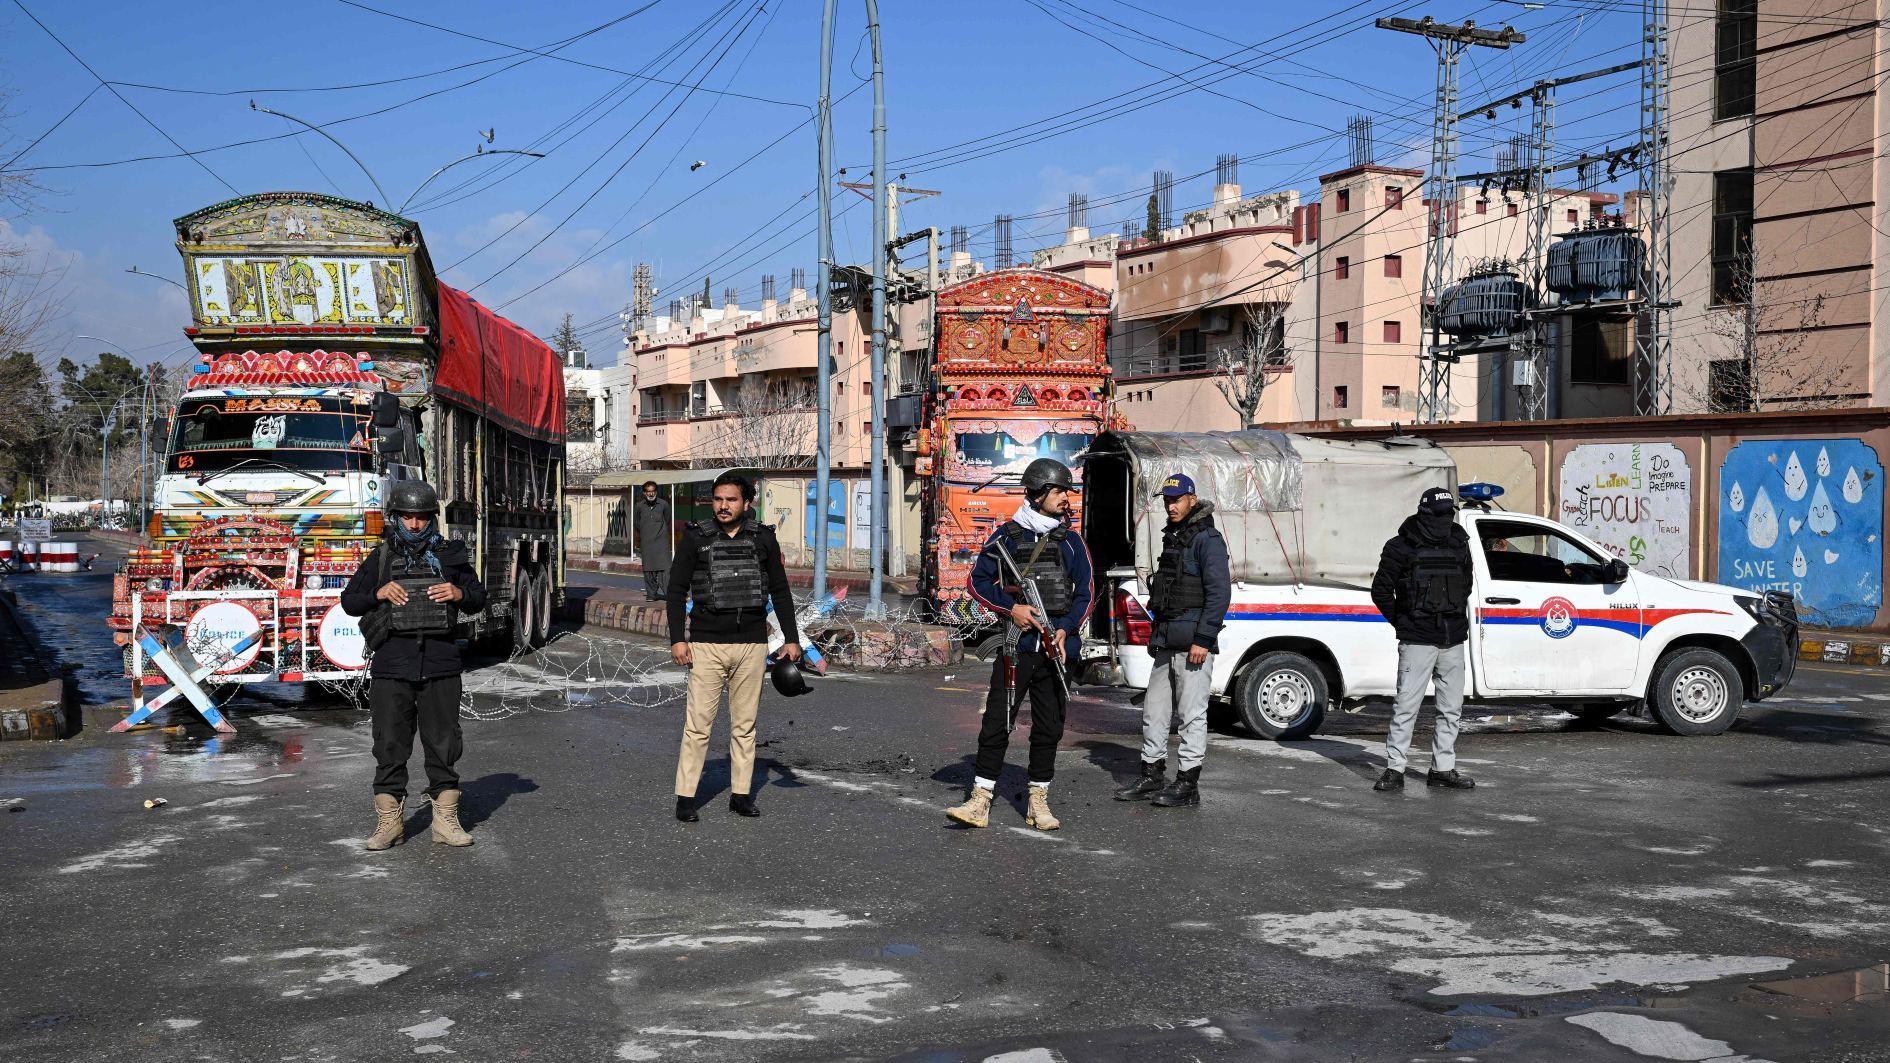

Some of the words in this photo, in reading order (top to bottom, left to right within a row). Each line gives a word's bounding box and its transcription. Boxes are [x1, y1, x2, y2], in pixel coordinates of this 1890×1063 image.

[1631, 441, 1641, 490] LEARN
[1650, 454, 1670, 471] Do
[1649, 481, 1686, 493] PREPARE
[1589, 495, 1651, 523] FOCUS
[1734, 558, 1776, 580] SAVE
